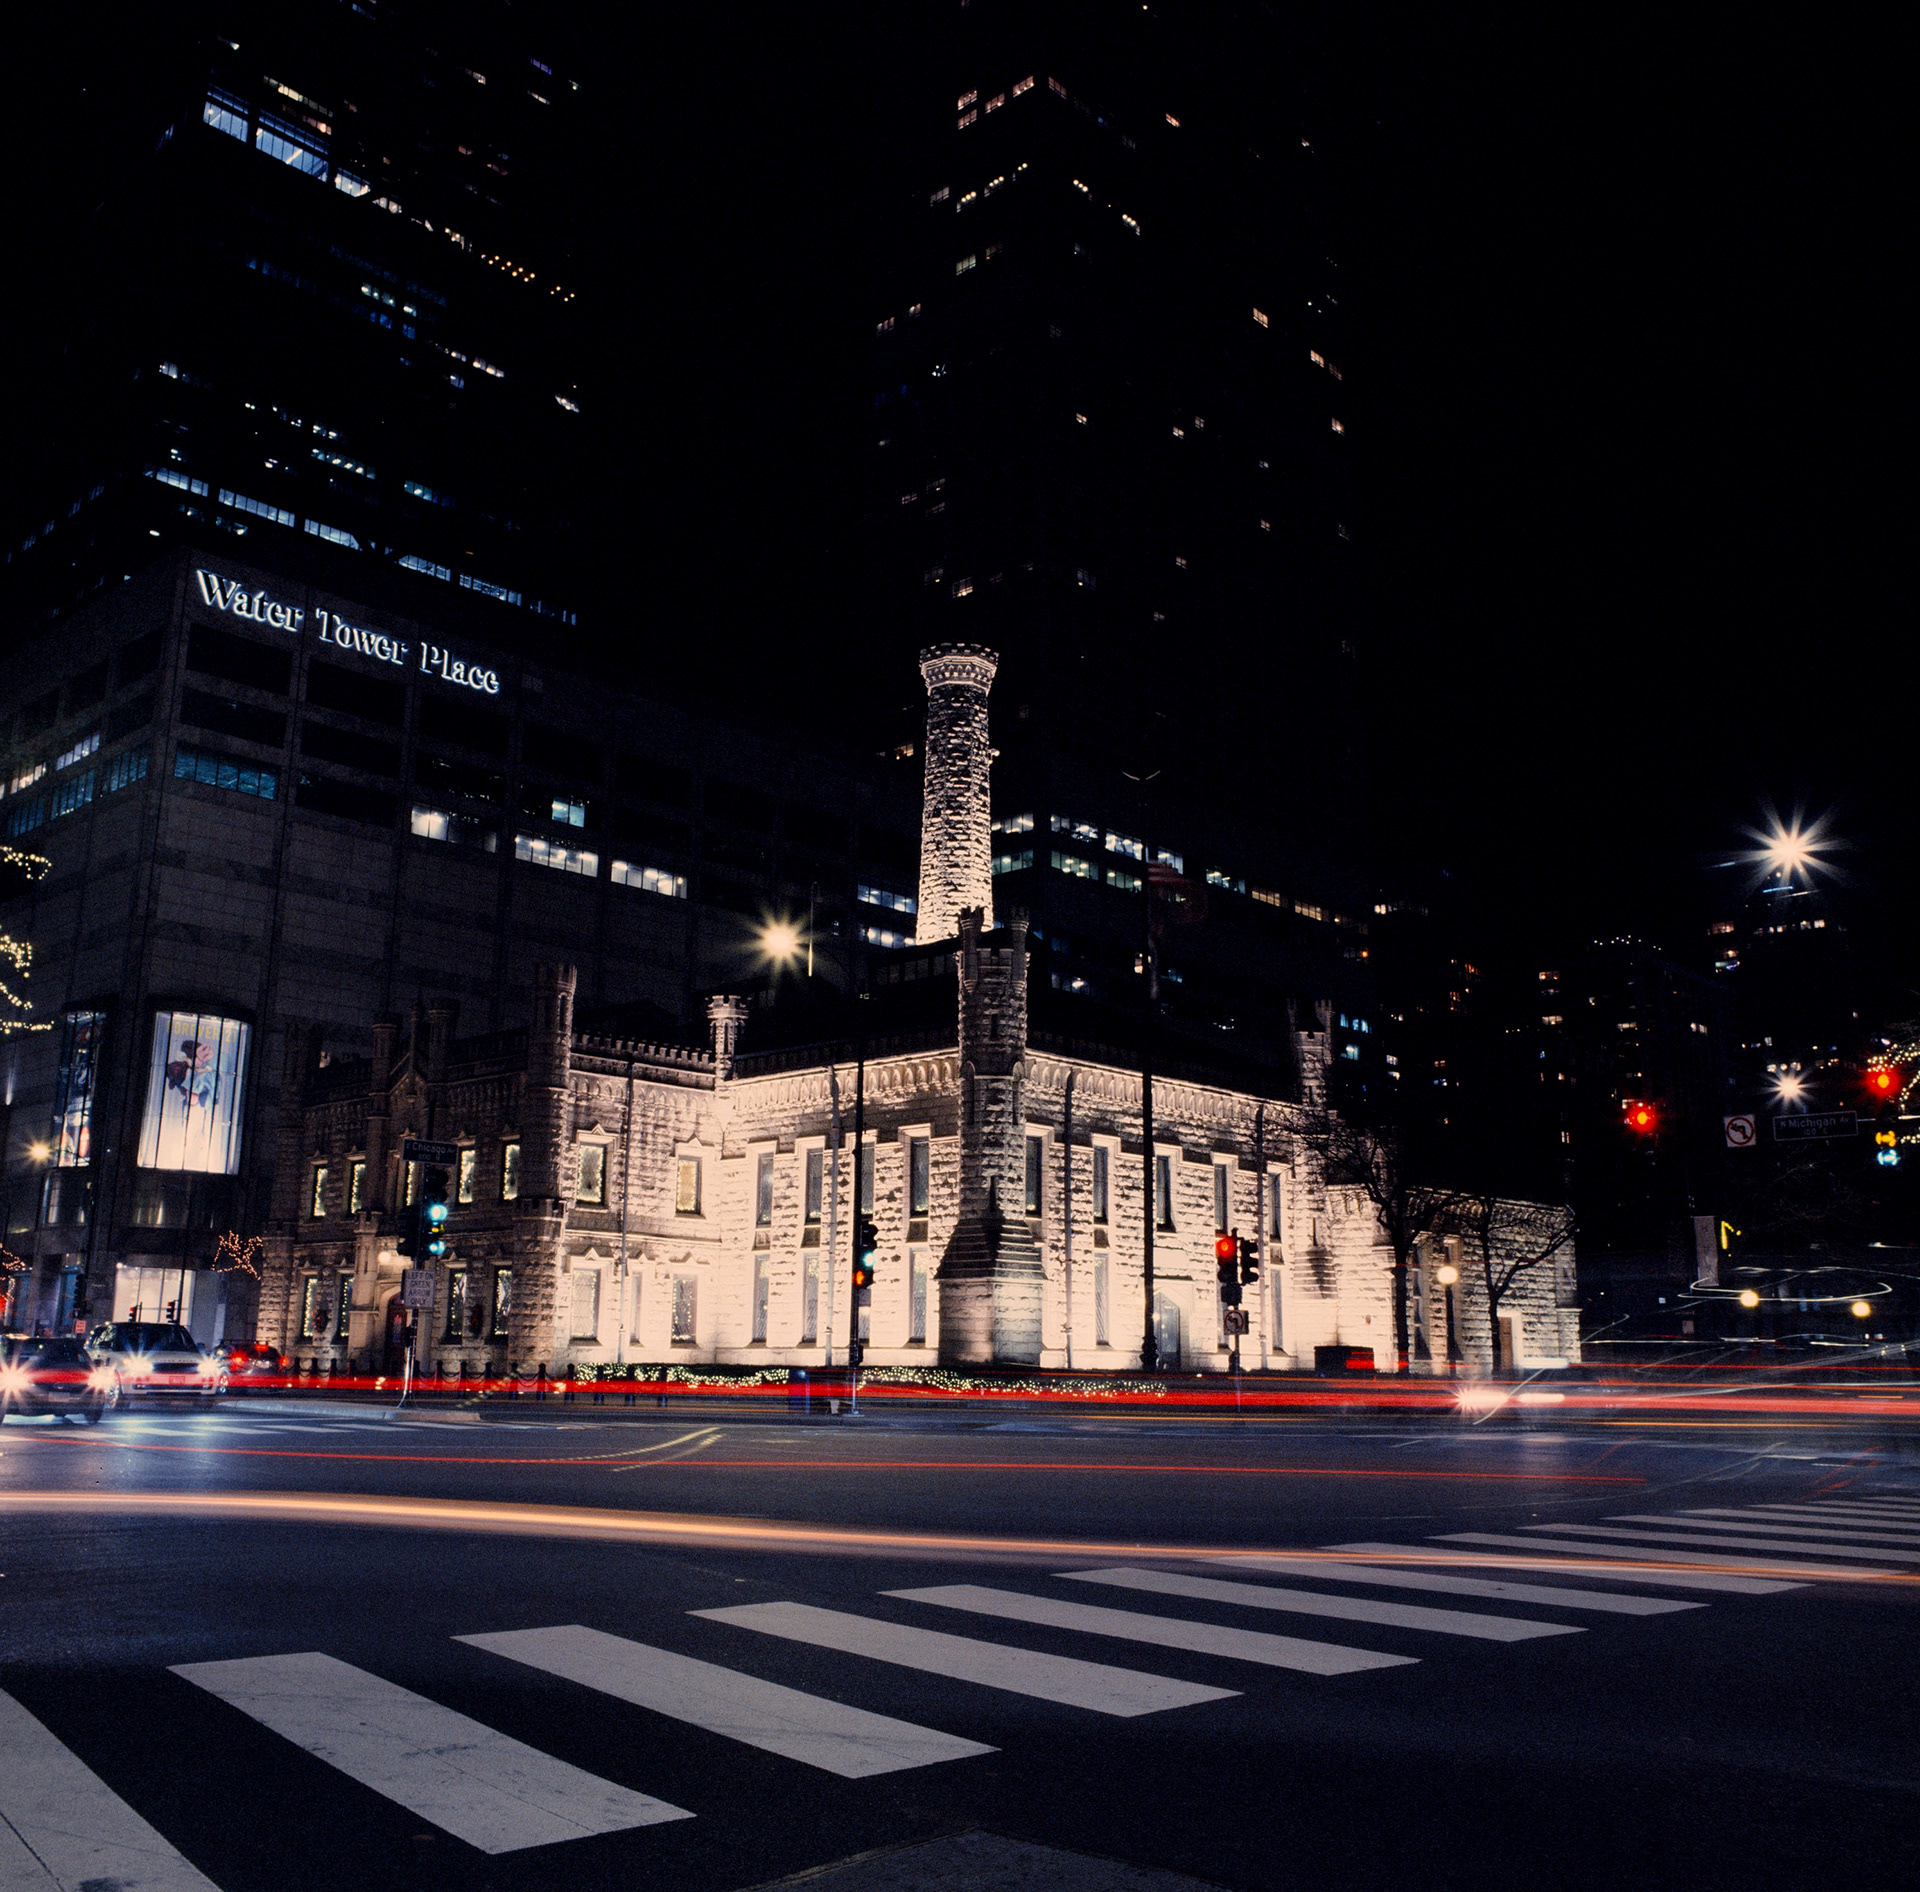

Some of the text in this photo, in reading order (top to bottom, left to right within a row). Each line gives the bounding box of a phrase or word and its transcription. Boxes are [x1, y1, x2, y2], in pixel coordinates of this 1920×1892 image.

[196, 568, 500, 694] Water Tower Place
[1788, 1117, 1837, 1129] Michigan
[412, 1141, 446, 1155] Chicago
[407, 1271, 434, 1280] LEFT ON
[410, 1280, 430, 1288] GREEN
[411, 1298, 426, 1306] ONLY
